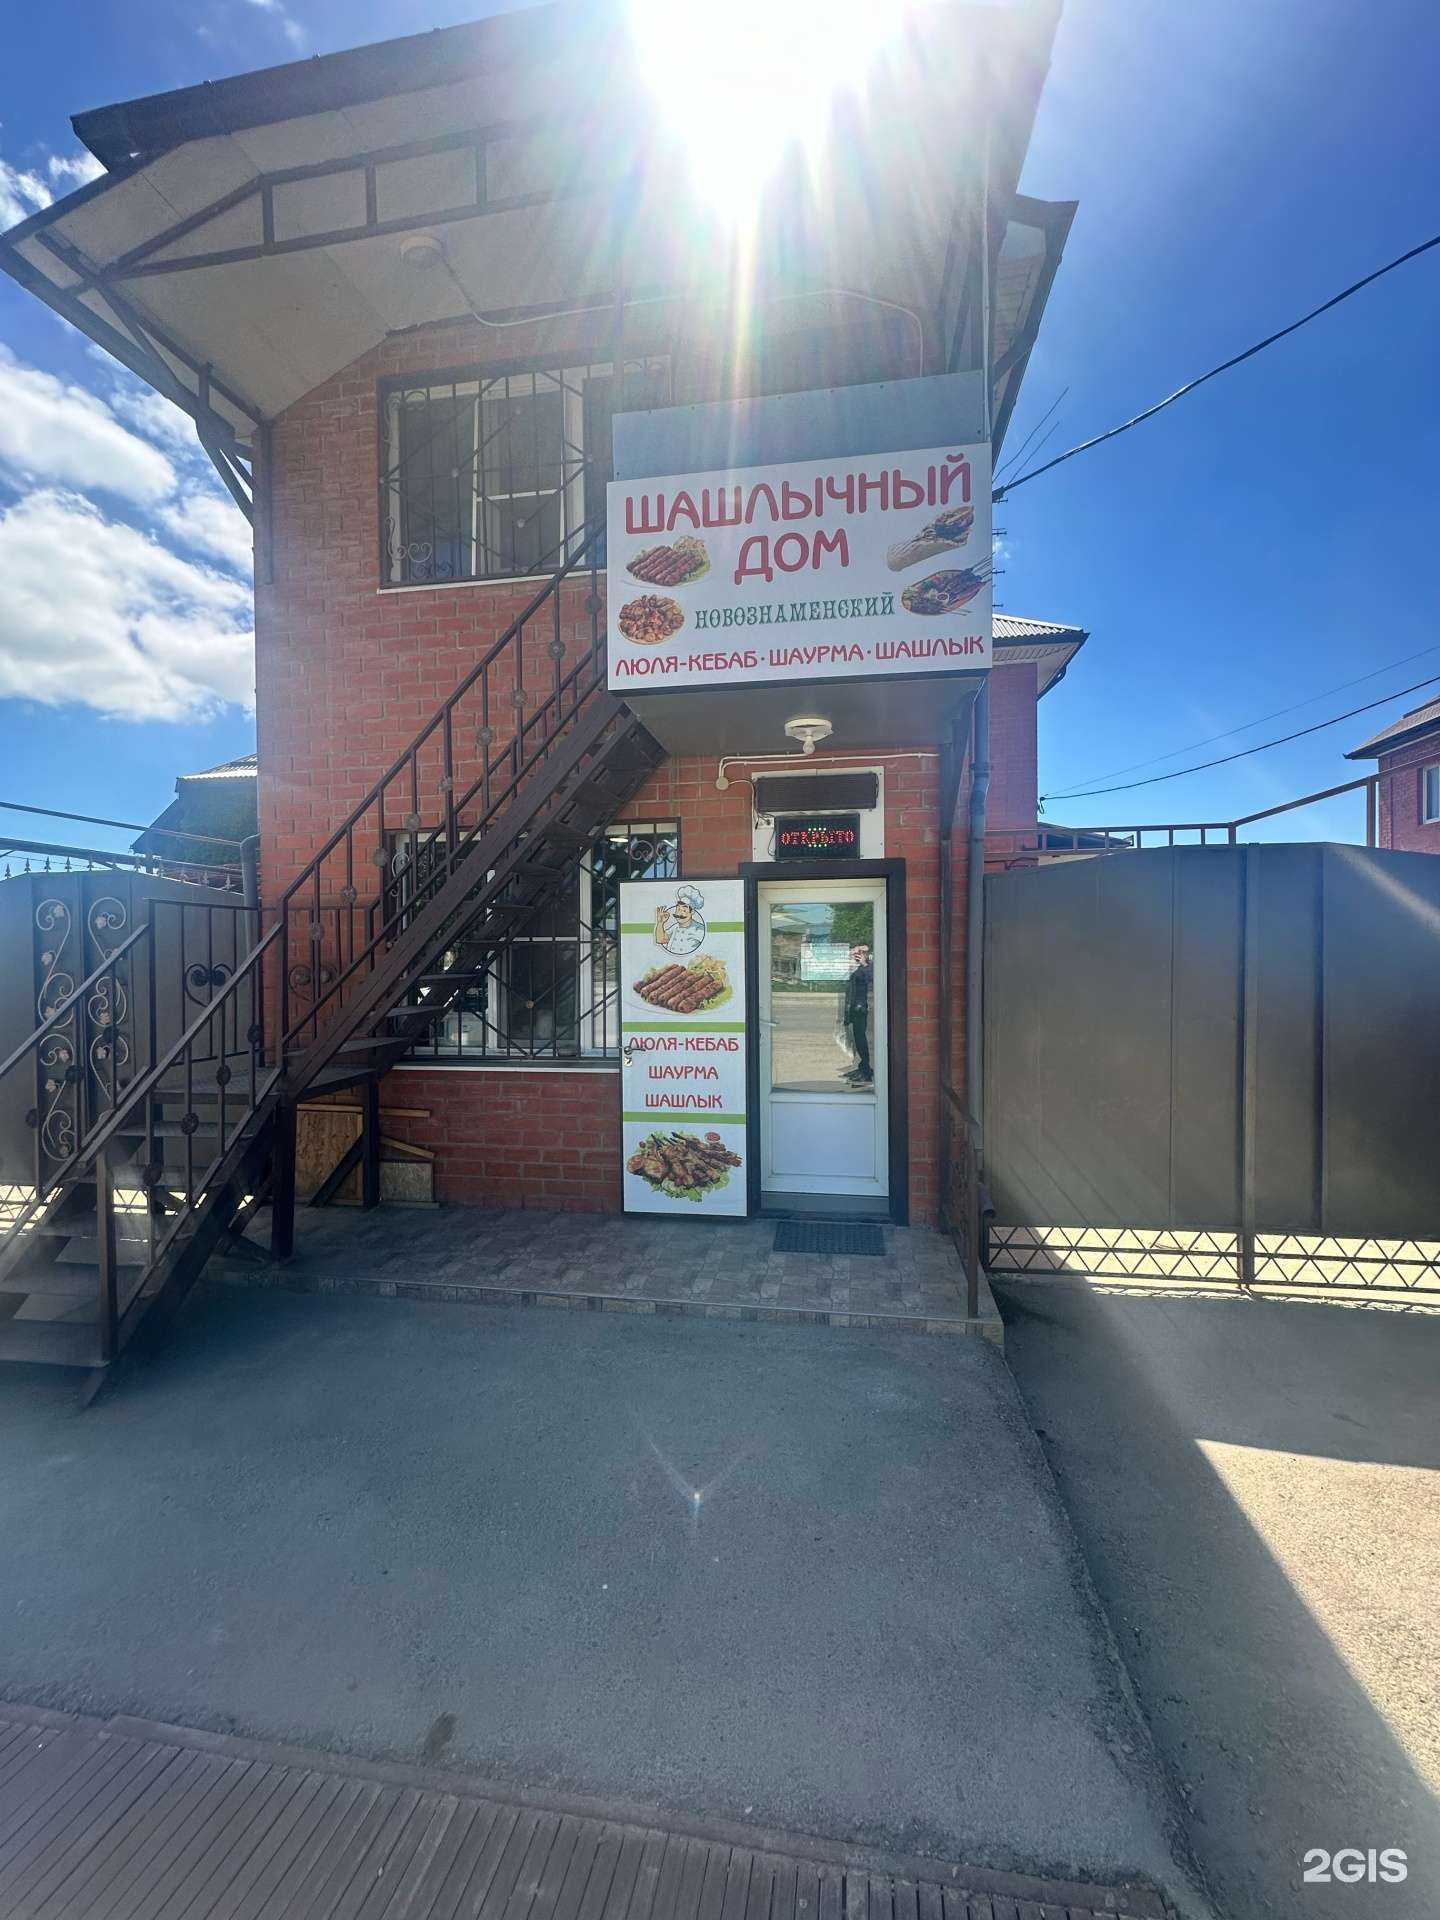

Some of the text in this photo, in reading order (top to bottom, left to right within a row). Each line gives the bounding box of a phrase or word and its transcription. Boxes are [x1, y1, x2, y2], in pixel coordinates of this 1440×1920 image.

[625, 452, 972, 535] ШАШЛЫЧНЫЙ
[734, 528, 850, 586] ДОМ
[694, 591, 896, 630] НОВОЗНАМЕНСКИЙ
[615, 635, 985, 677] ЛЮЛЯ-КЕБАБ ШАУРМА ШАШЛЫК
[780, 828, 856, 846] ОТКРЫТО
[628, 1036, 740, 1052] ЛЮЛЯ-КЕБАБ
[648, 1065, 720, 1080] ШАУРМА
[645, 1093, 723, 1109] ШАШЛЫК
